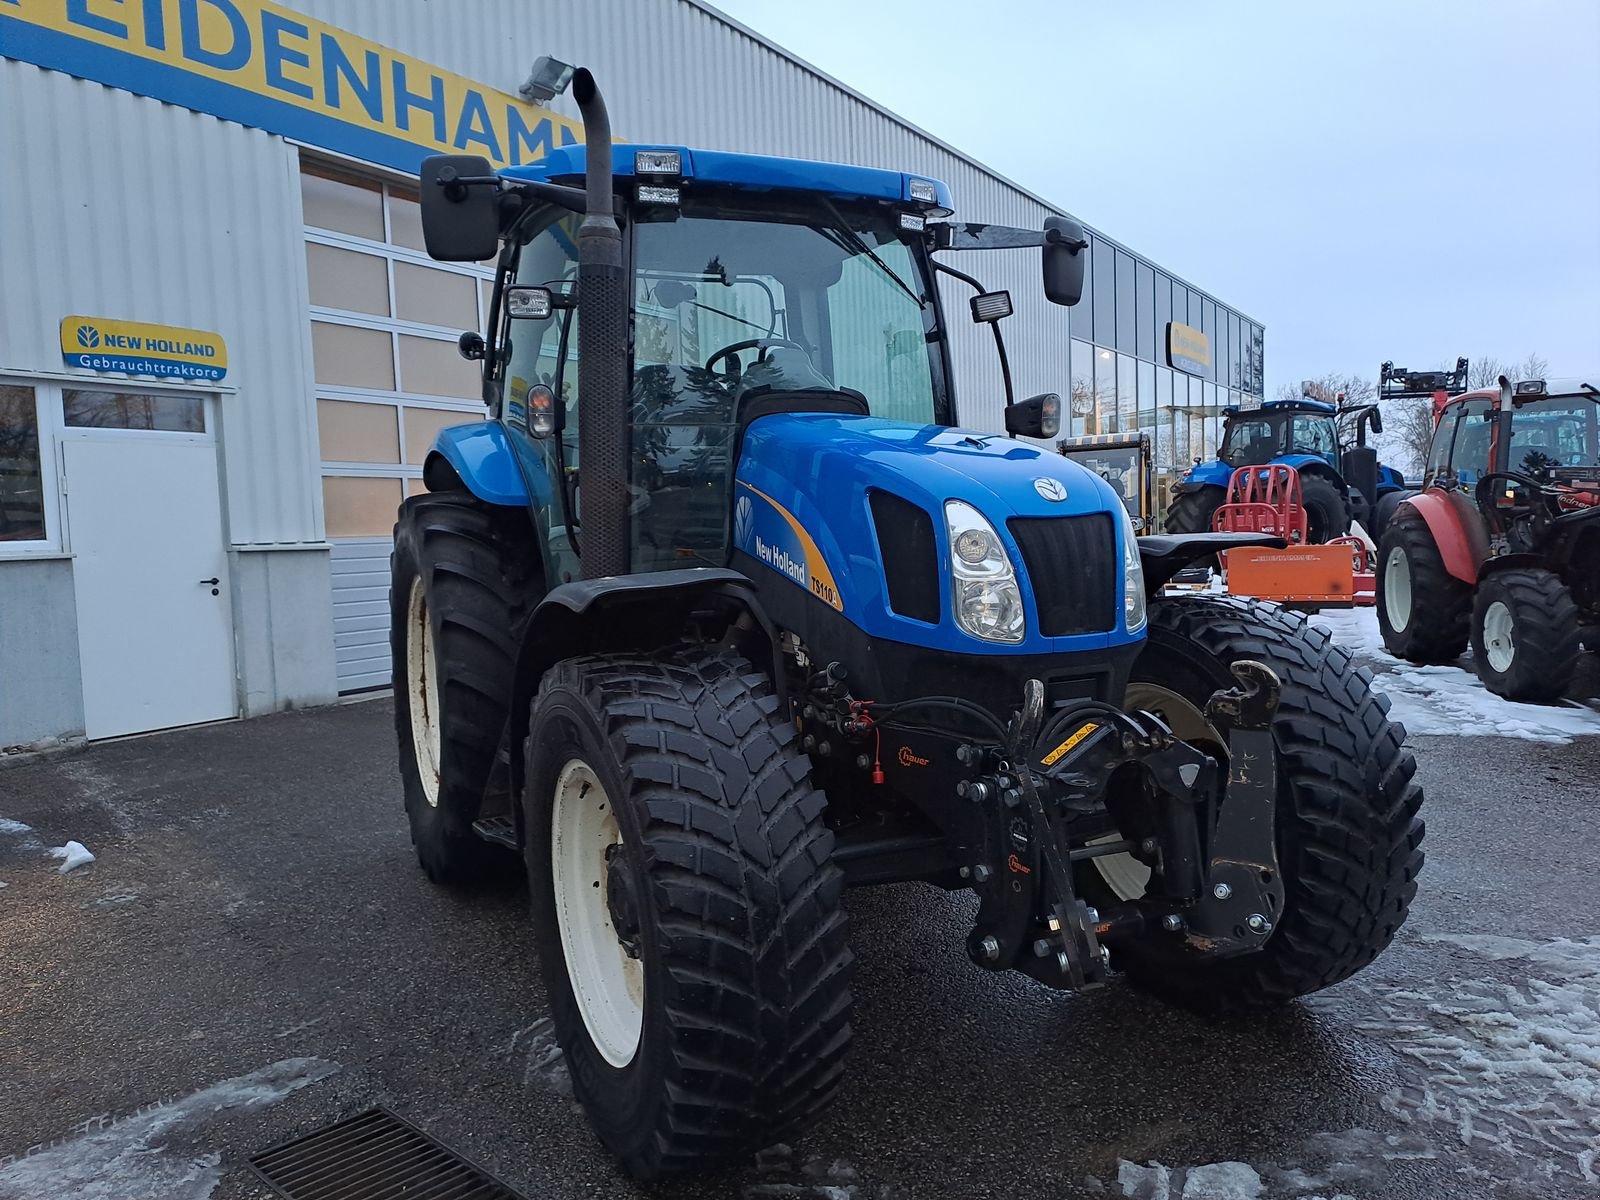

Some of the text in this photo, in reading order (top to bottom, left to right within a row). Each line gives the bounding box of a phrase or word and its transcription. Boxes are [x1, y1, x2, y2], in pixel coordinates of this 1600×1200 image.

[104, 334, 215, 357] NEW HOLLAND
[79, 355, 218, 378] Gebrauchttraktore
[755, 536, 805, 584] New Holland
[903, 751, 929, 766] hauer
